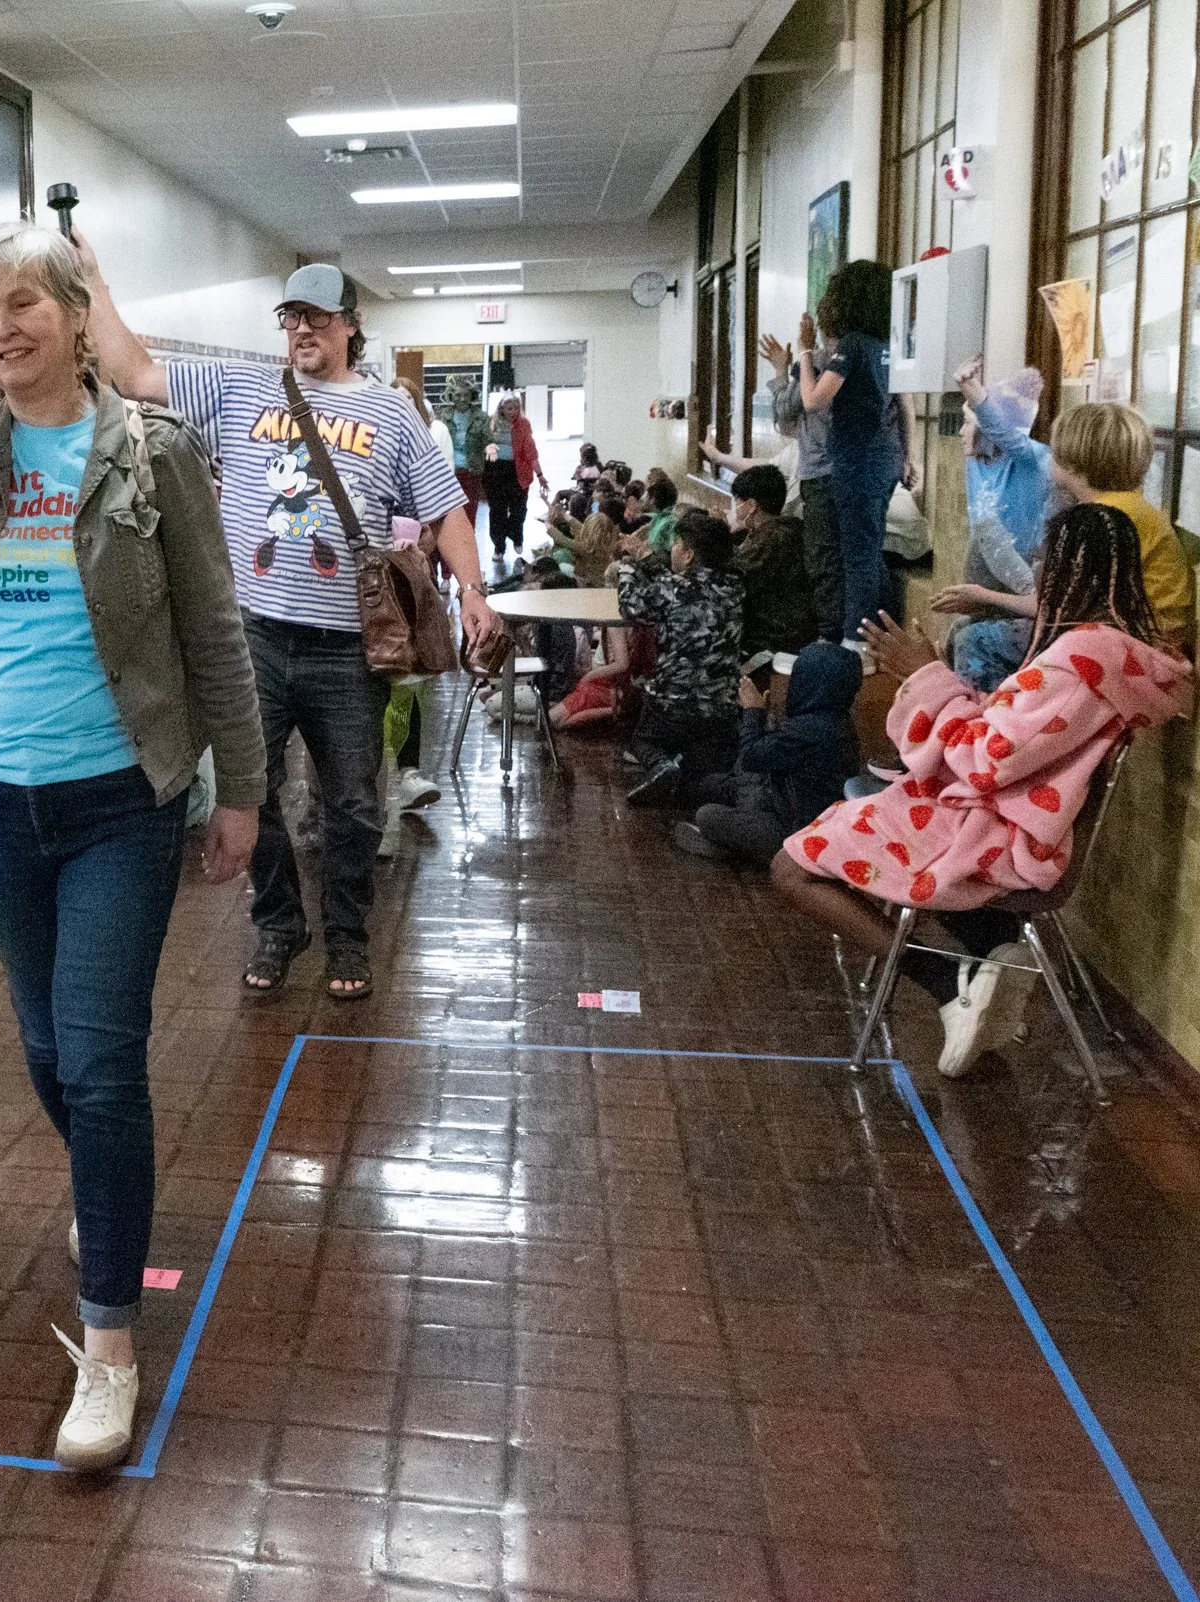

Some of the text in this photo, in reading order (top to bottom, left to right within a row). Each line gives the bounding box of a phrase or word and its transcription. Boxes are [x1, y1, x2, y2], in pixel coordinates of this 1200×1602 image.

[940, 150, 974, 167] AD
[480, 304, 500, 320] EXIT
[7, 491, 81, 518] uddi
[0, 524, 76, 541] onnect
